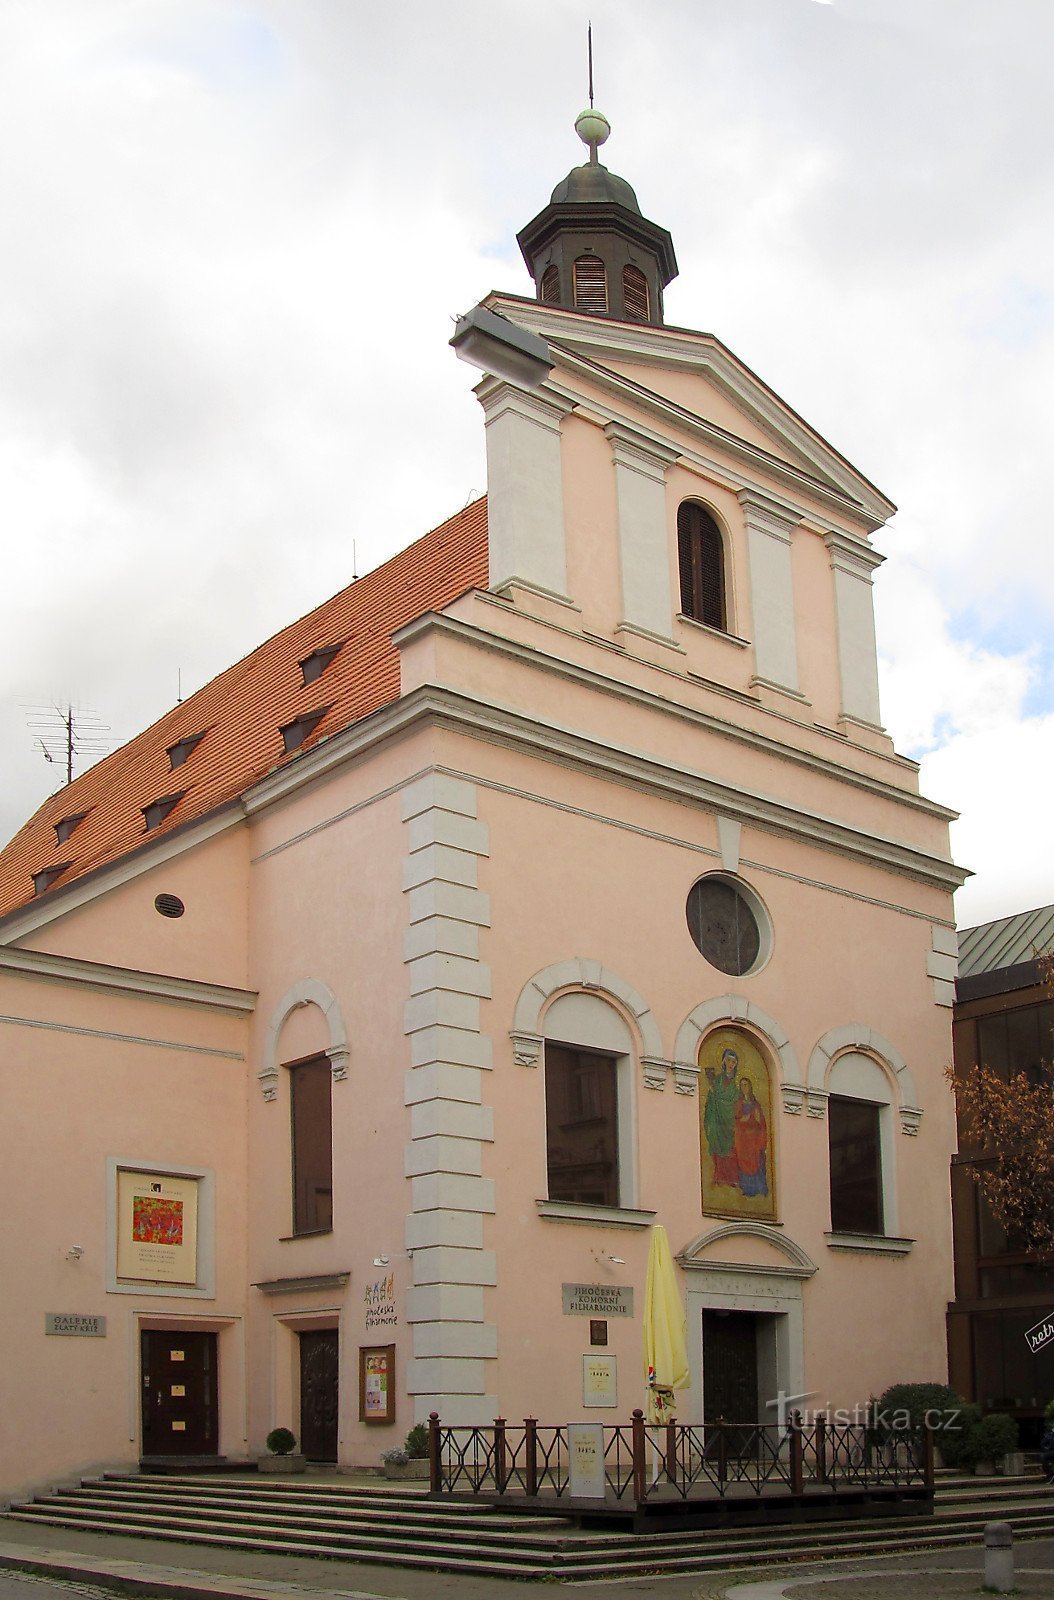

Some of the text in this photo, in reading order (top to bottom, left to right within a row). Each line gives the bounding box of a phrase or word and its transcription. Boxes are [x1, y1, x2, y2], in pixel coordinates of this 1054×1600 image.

[574, 1286, 622, 1297] JIHOČESKÁ
[570, 1302, 627, 1312] FILHARMONIE
[54, 1316, 98, 1326] GALERIE
